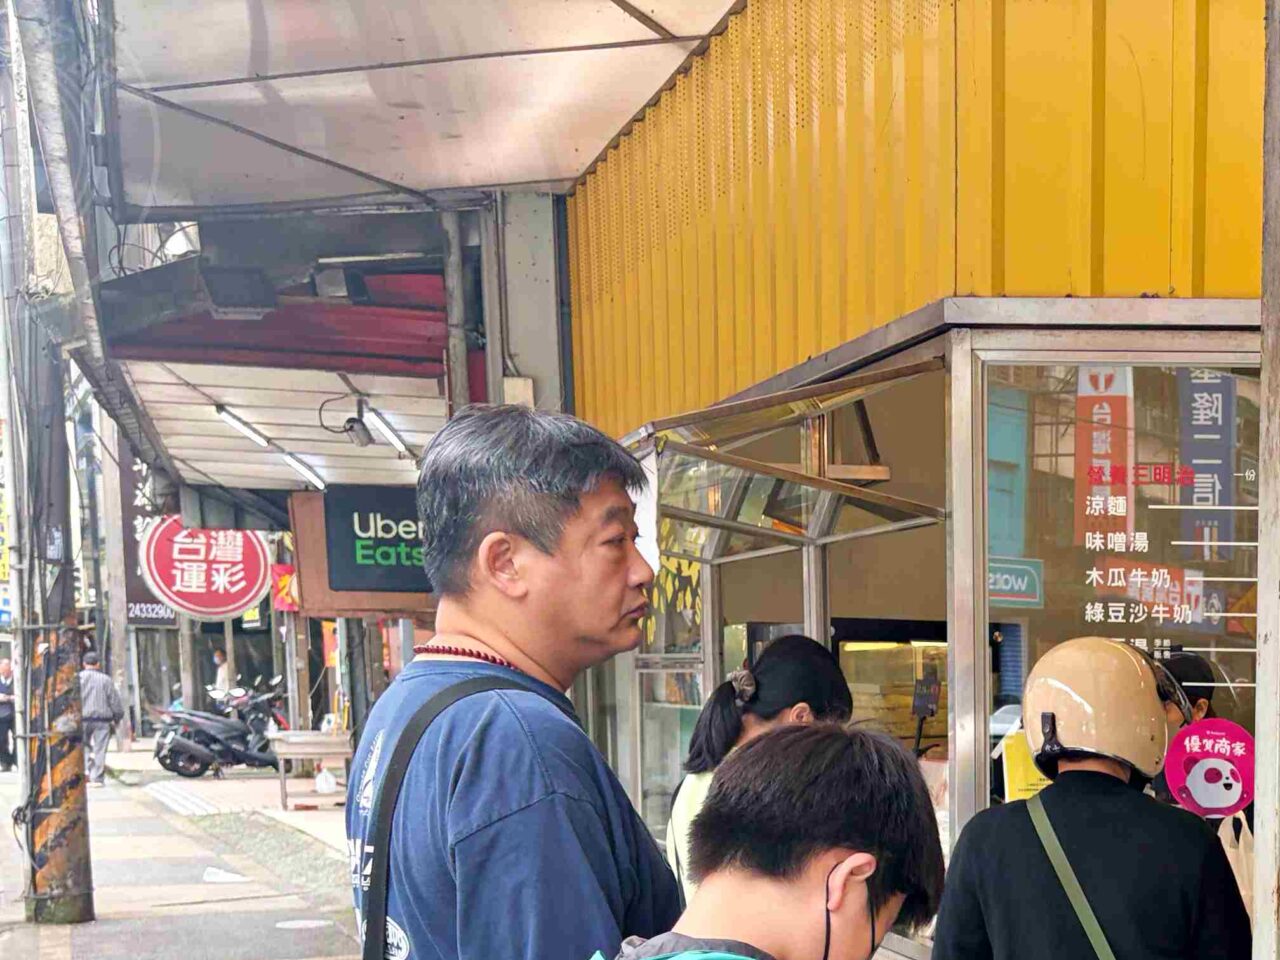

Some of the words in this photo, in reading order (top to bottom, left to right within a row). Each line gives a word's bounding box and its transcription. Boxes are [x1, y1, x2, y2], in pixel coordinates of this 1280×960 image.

[1085, 496, 1127, 516] 涼麵
[172, 529, 244, 561] 台灣
[355, 540, 425, 566] Eats
[1085, 532, 1149, 553] 味噌湯
[171, 562, 247, 594] 運彩
[1085, 568, 1171, 588] 木瓜牛奶
[1084, 602, 1192, 625] 綠豆沙牛奶
